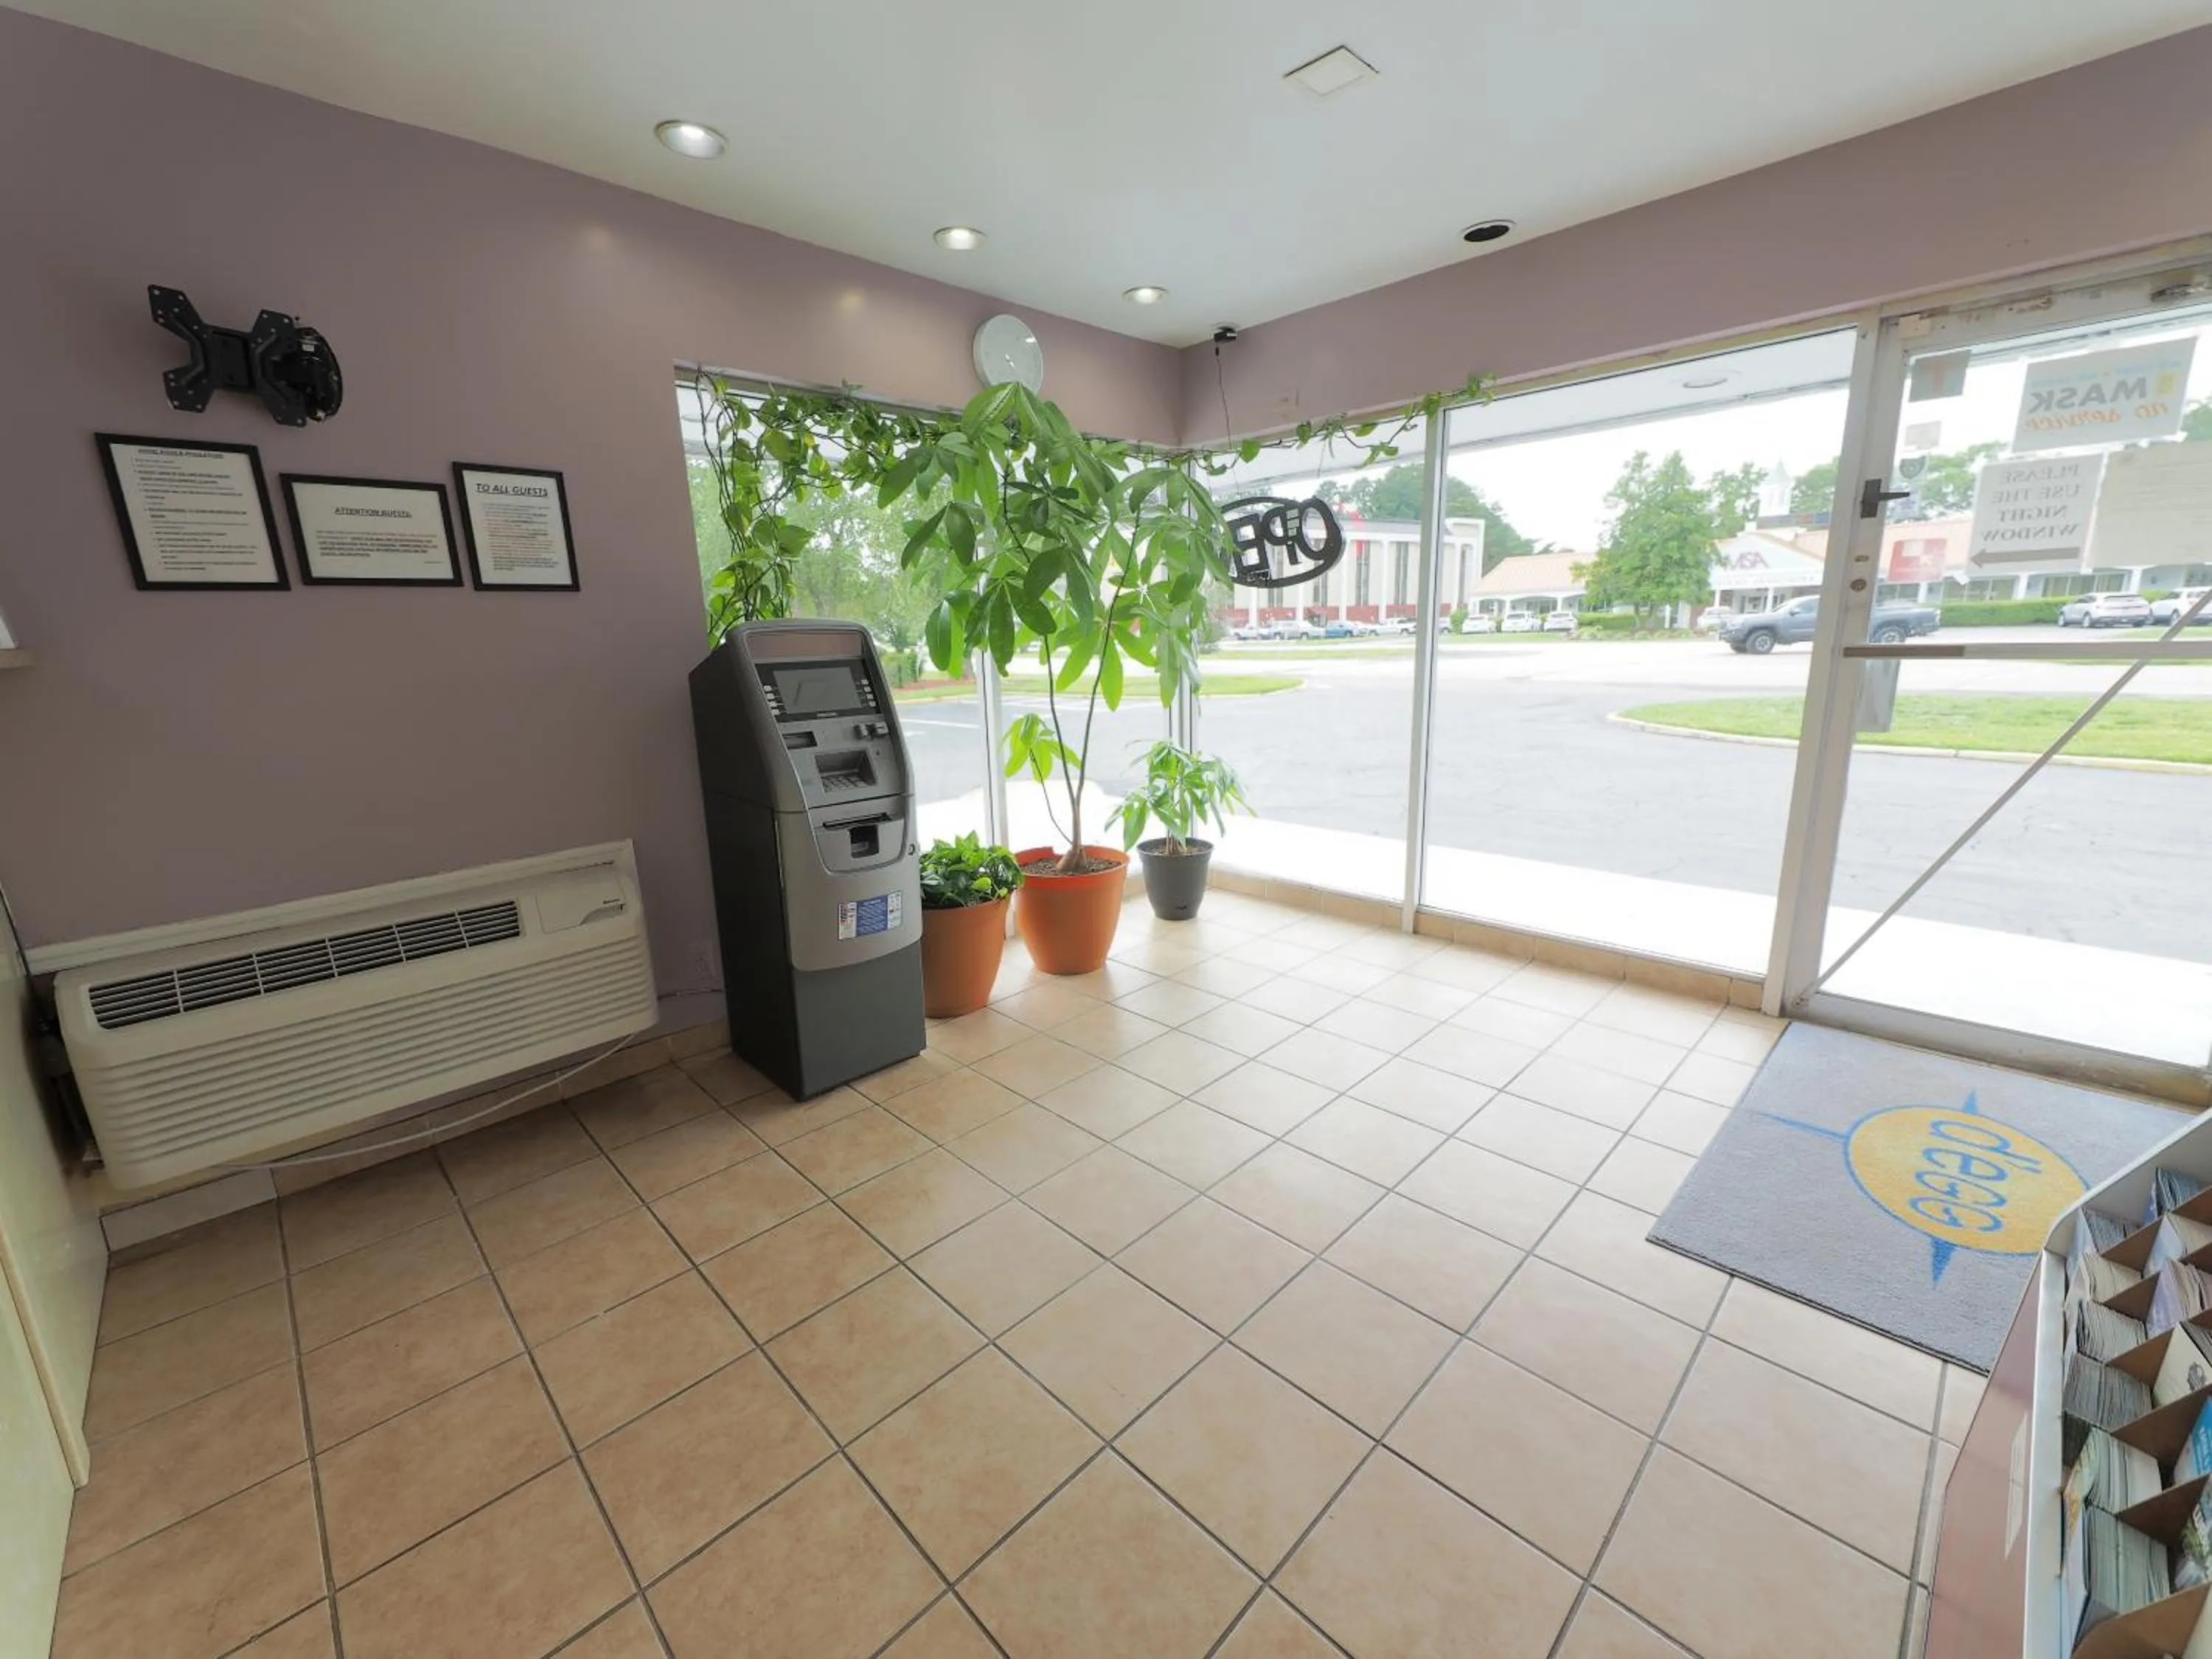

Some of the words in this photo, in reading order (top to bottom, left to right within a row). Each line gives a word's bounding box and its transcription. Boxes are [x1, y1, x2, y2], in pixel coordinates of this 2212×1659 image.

[475, 483, 490, 492] TO
[492, 484, 509, 494] ALL
[512, 486, 548, 497] GUESTS
